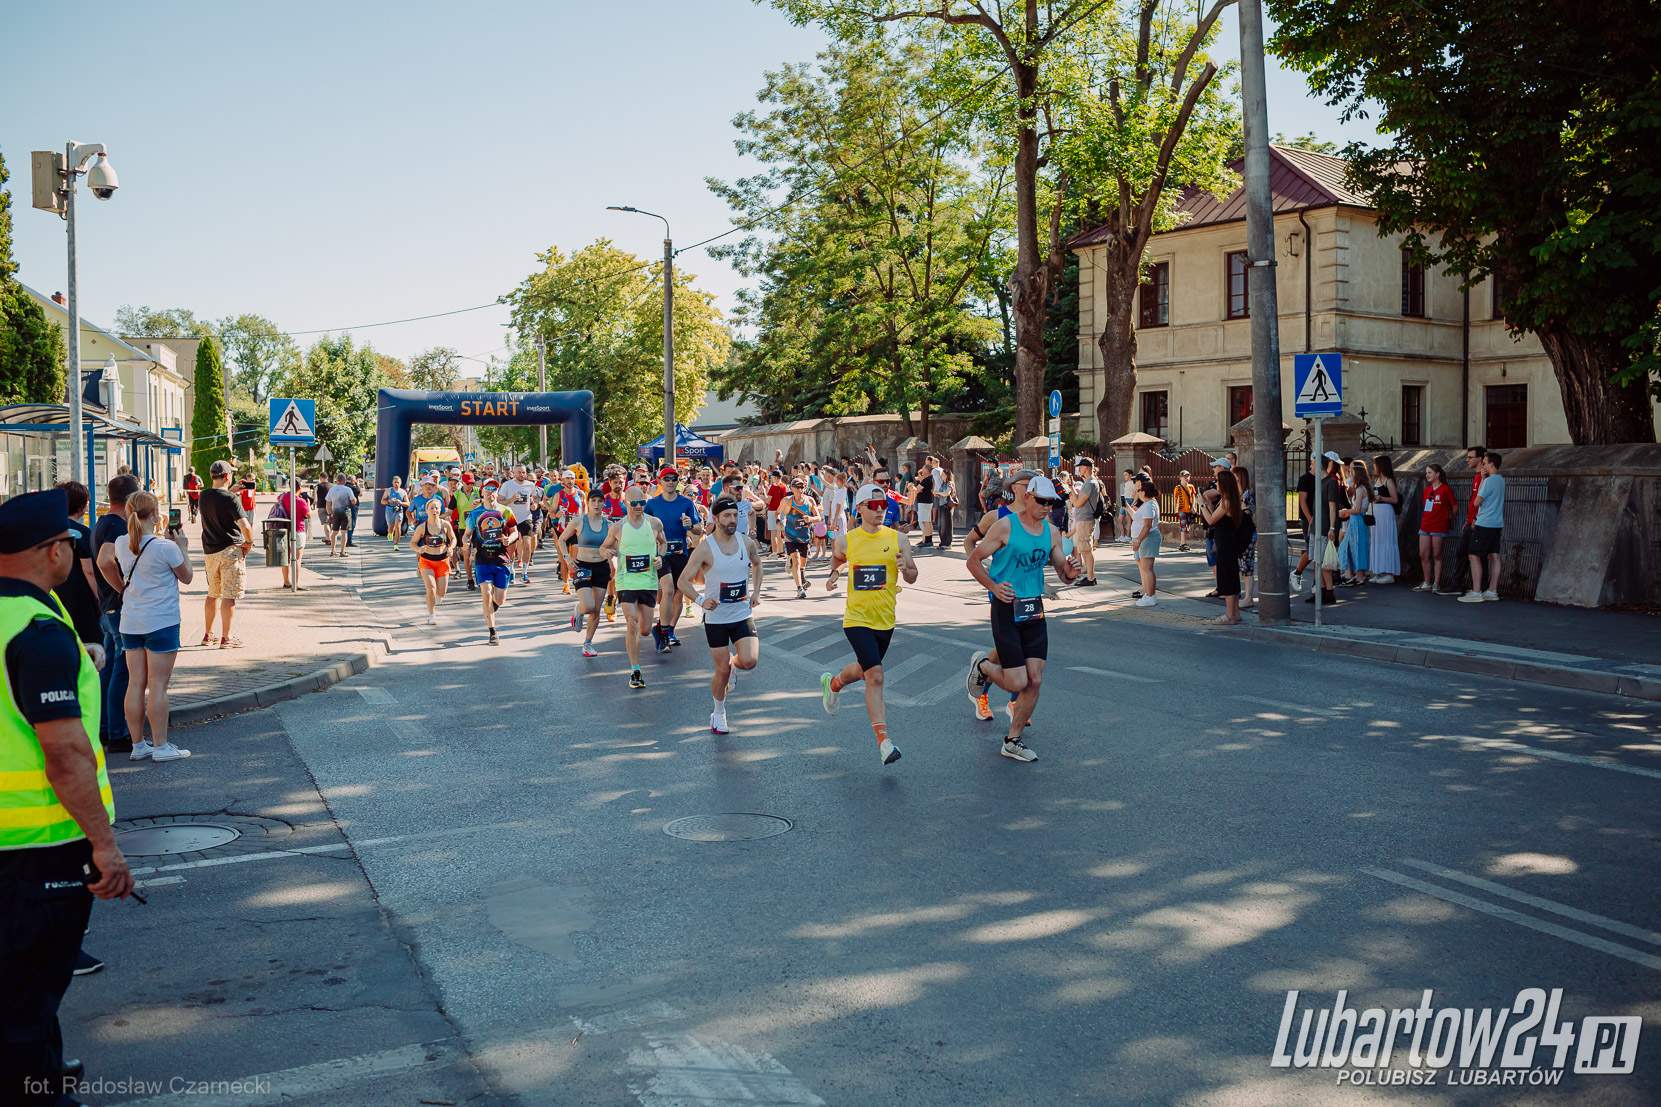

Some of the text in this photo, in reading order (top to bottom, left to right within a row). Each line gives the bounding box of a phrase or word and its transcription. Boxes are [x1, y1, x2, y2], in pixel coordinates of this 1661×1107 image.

[461, 400, 519, 416] START
[631, 560, 645, 568] 126
[863, 574, 876, 582] 24
[730, 589, 740, 597] 87
[1024, 603, 1035, 612] 28
